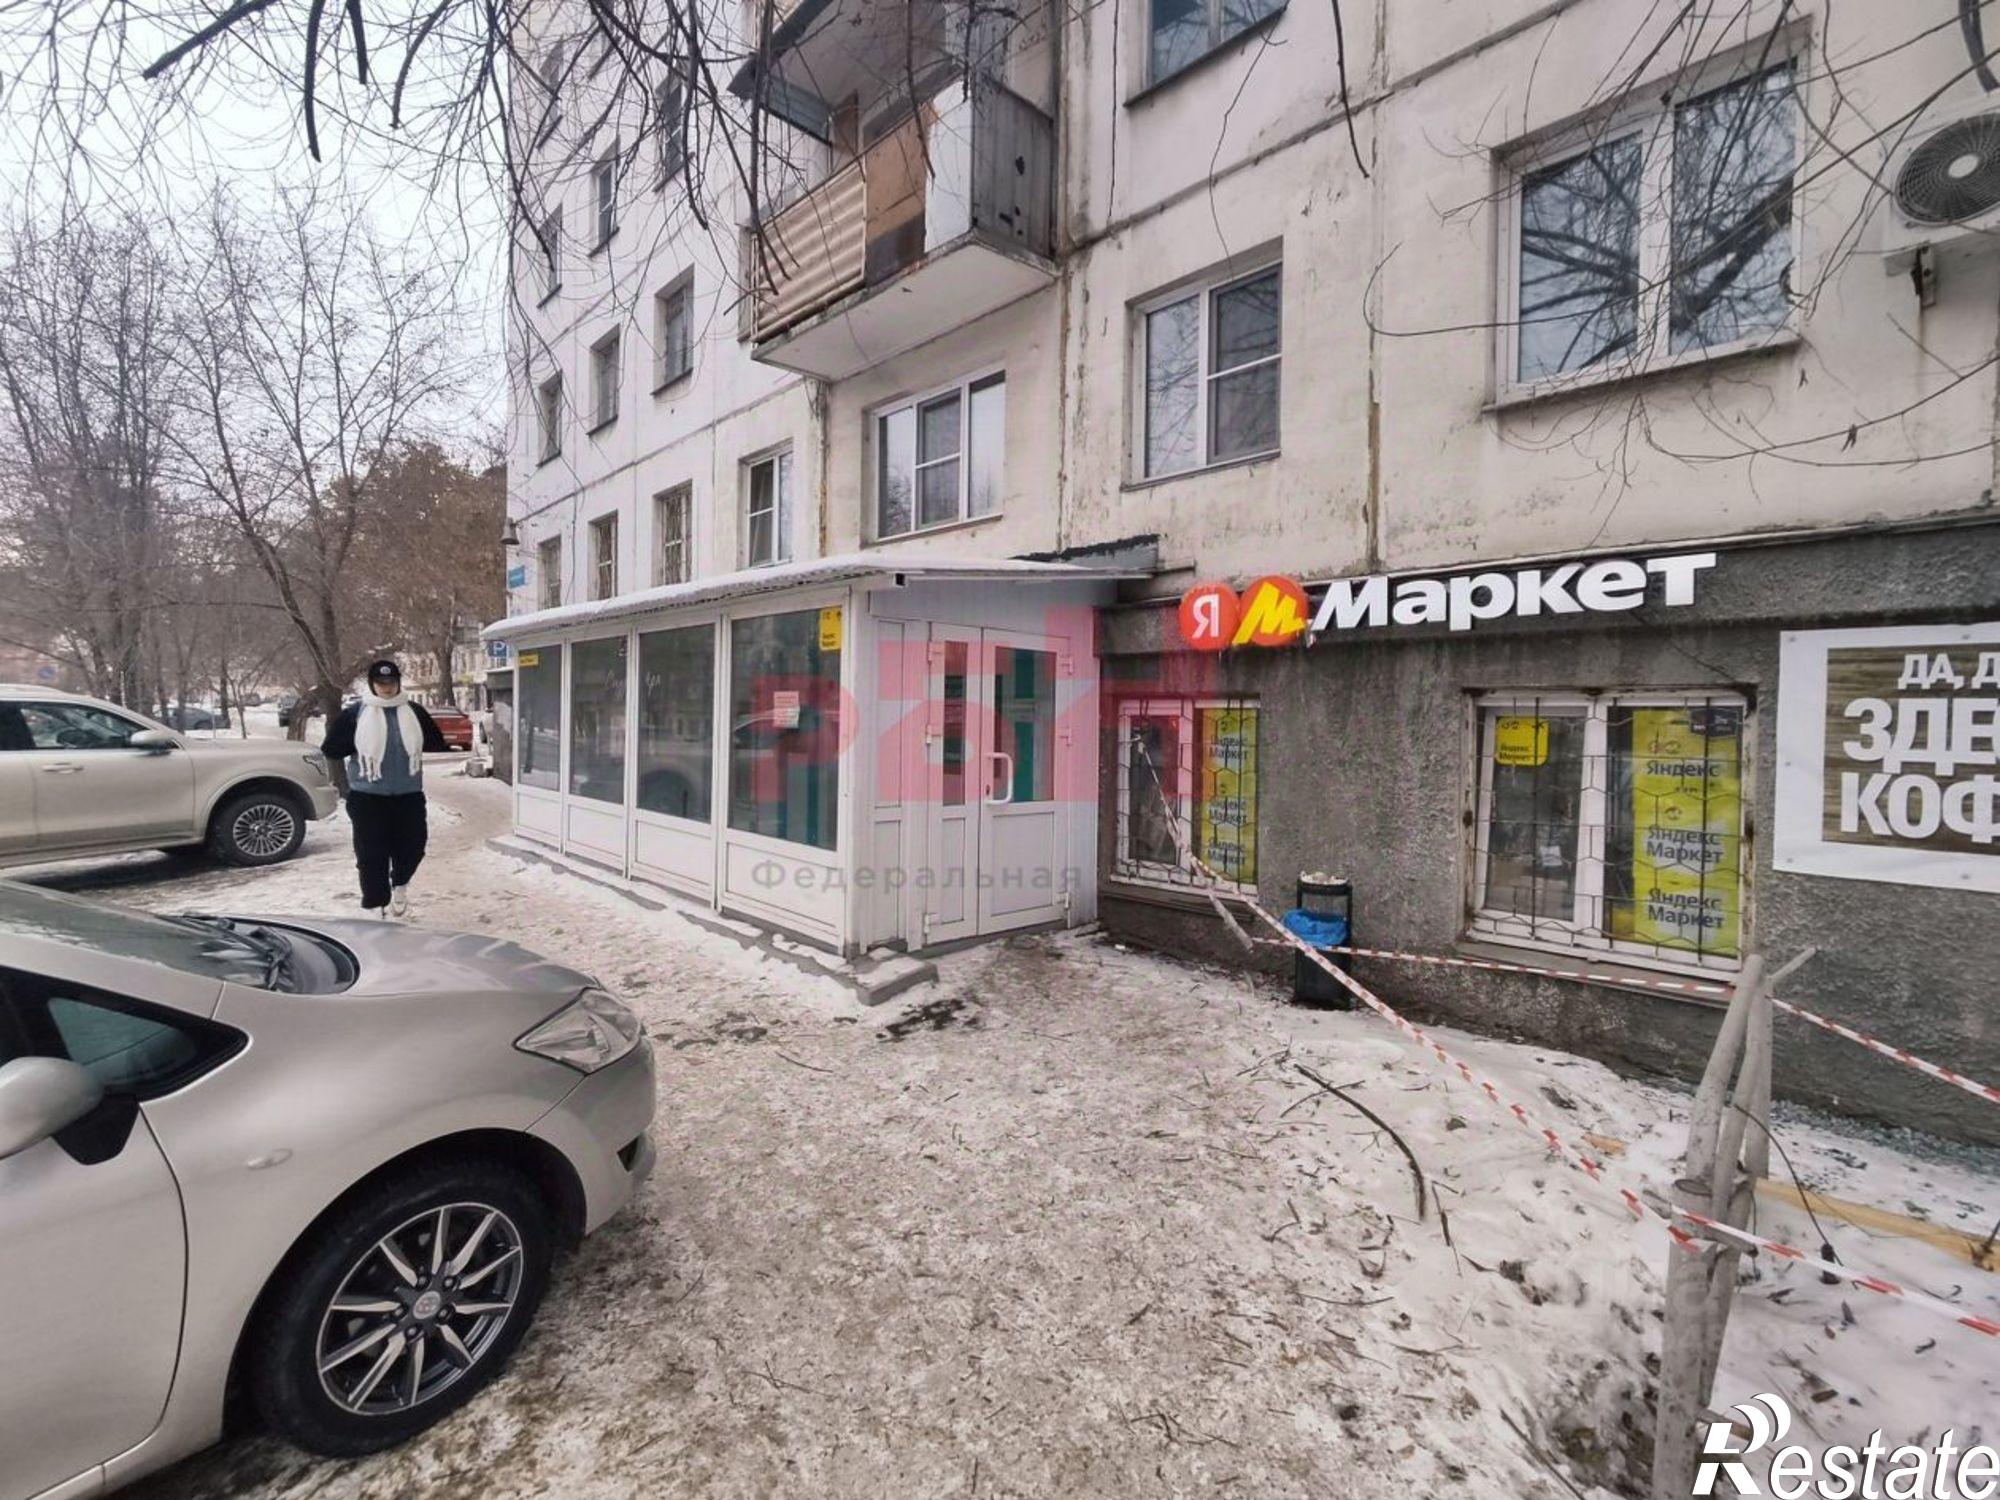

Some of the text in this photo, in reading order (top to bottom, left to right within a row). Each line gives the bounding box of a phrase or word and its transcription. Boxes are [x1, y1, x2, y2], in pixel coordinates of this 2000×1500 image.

[1192, 593, 1220, 639] Я
[1310, 552, 1717, 632] Маркет
[1898, 652, 1965, 690] ДА,
[1843, 697, 2000, 776] ЗДЕ
[1648, 824, 1721, 845] Яндекс
[1646, 840, 1724, 864] Маркет
[1649, 888, 1721, 910] Яндекс
[1648, 904, 1724, 928] Маркет
